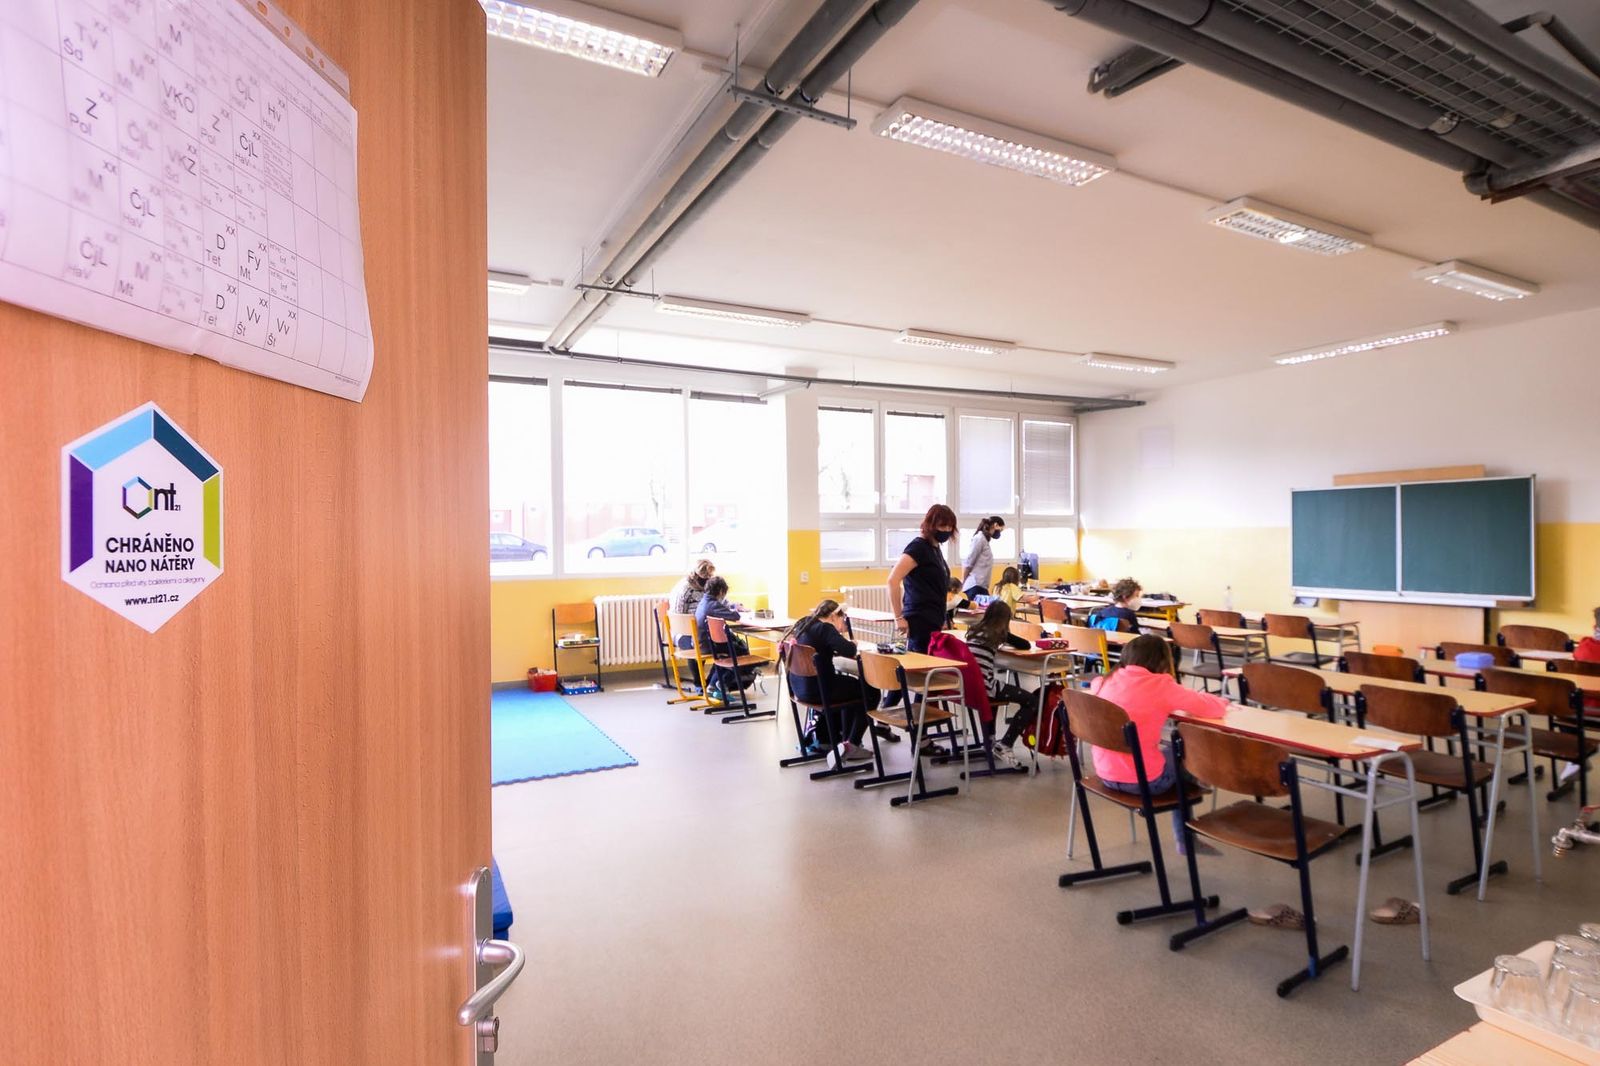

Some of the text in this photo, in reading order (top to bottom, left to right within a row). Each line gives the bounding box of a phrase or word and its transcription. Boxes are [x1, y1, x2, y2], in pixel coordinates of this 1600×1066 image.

[169, 23, 183, 46] M
[162, 79, 195, 113] VKO
[85, 97, 98, 119] Z
[212, 114, 221, 132] Z
[216, 234, 226, 250] D
[206, 249, 221, 267] Tet
[247, 250, 261, 271] Fy
[134, 260, 149, 282] M
[215, 294, 226, 310] D
[246, 306, 261, 324] Vv
[276, 318, 290, 335] Vv
[154, 483, 176, 511] nt
[106, 533, 194, 553] CHRÁNĚNO
[105, 555, 195, 573] NANO NÁTĚRY
[125, 594, 179, 606] www.nt21.cz
